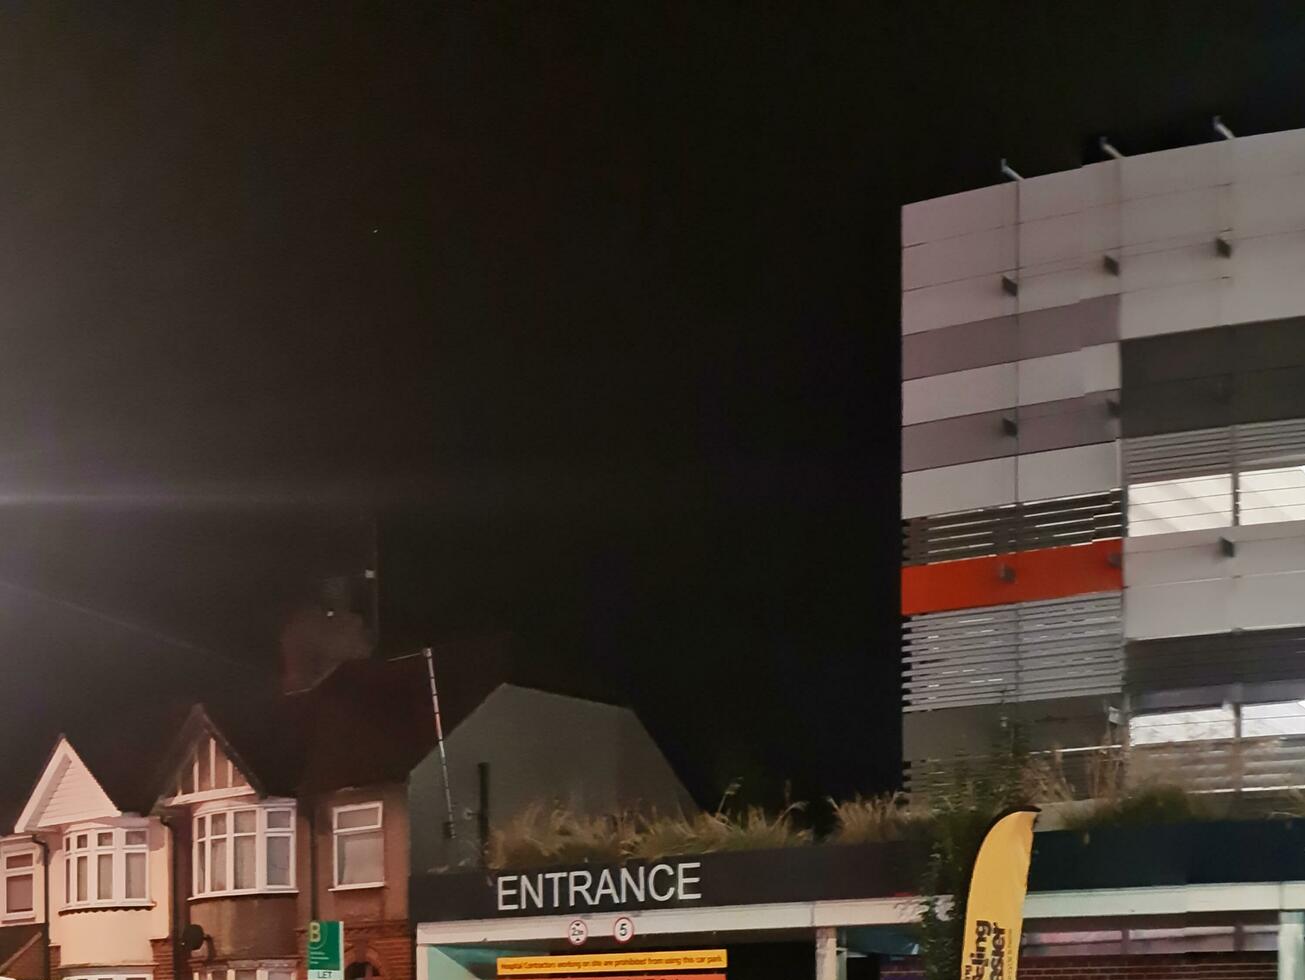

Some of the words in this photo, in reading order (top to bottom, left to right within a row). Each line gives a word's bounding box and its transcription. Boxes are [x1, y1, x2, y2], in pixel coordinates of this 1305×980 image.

[497, 862, 702, 911] ENTRANCE
[619, 922, 628, 937] 5
[317, 971, 333, 979] LET
